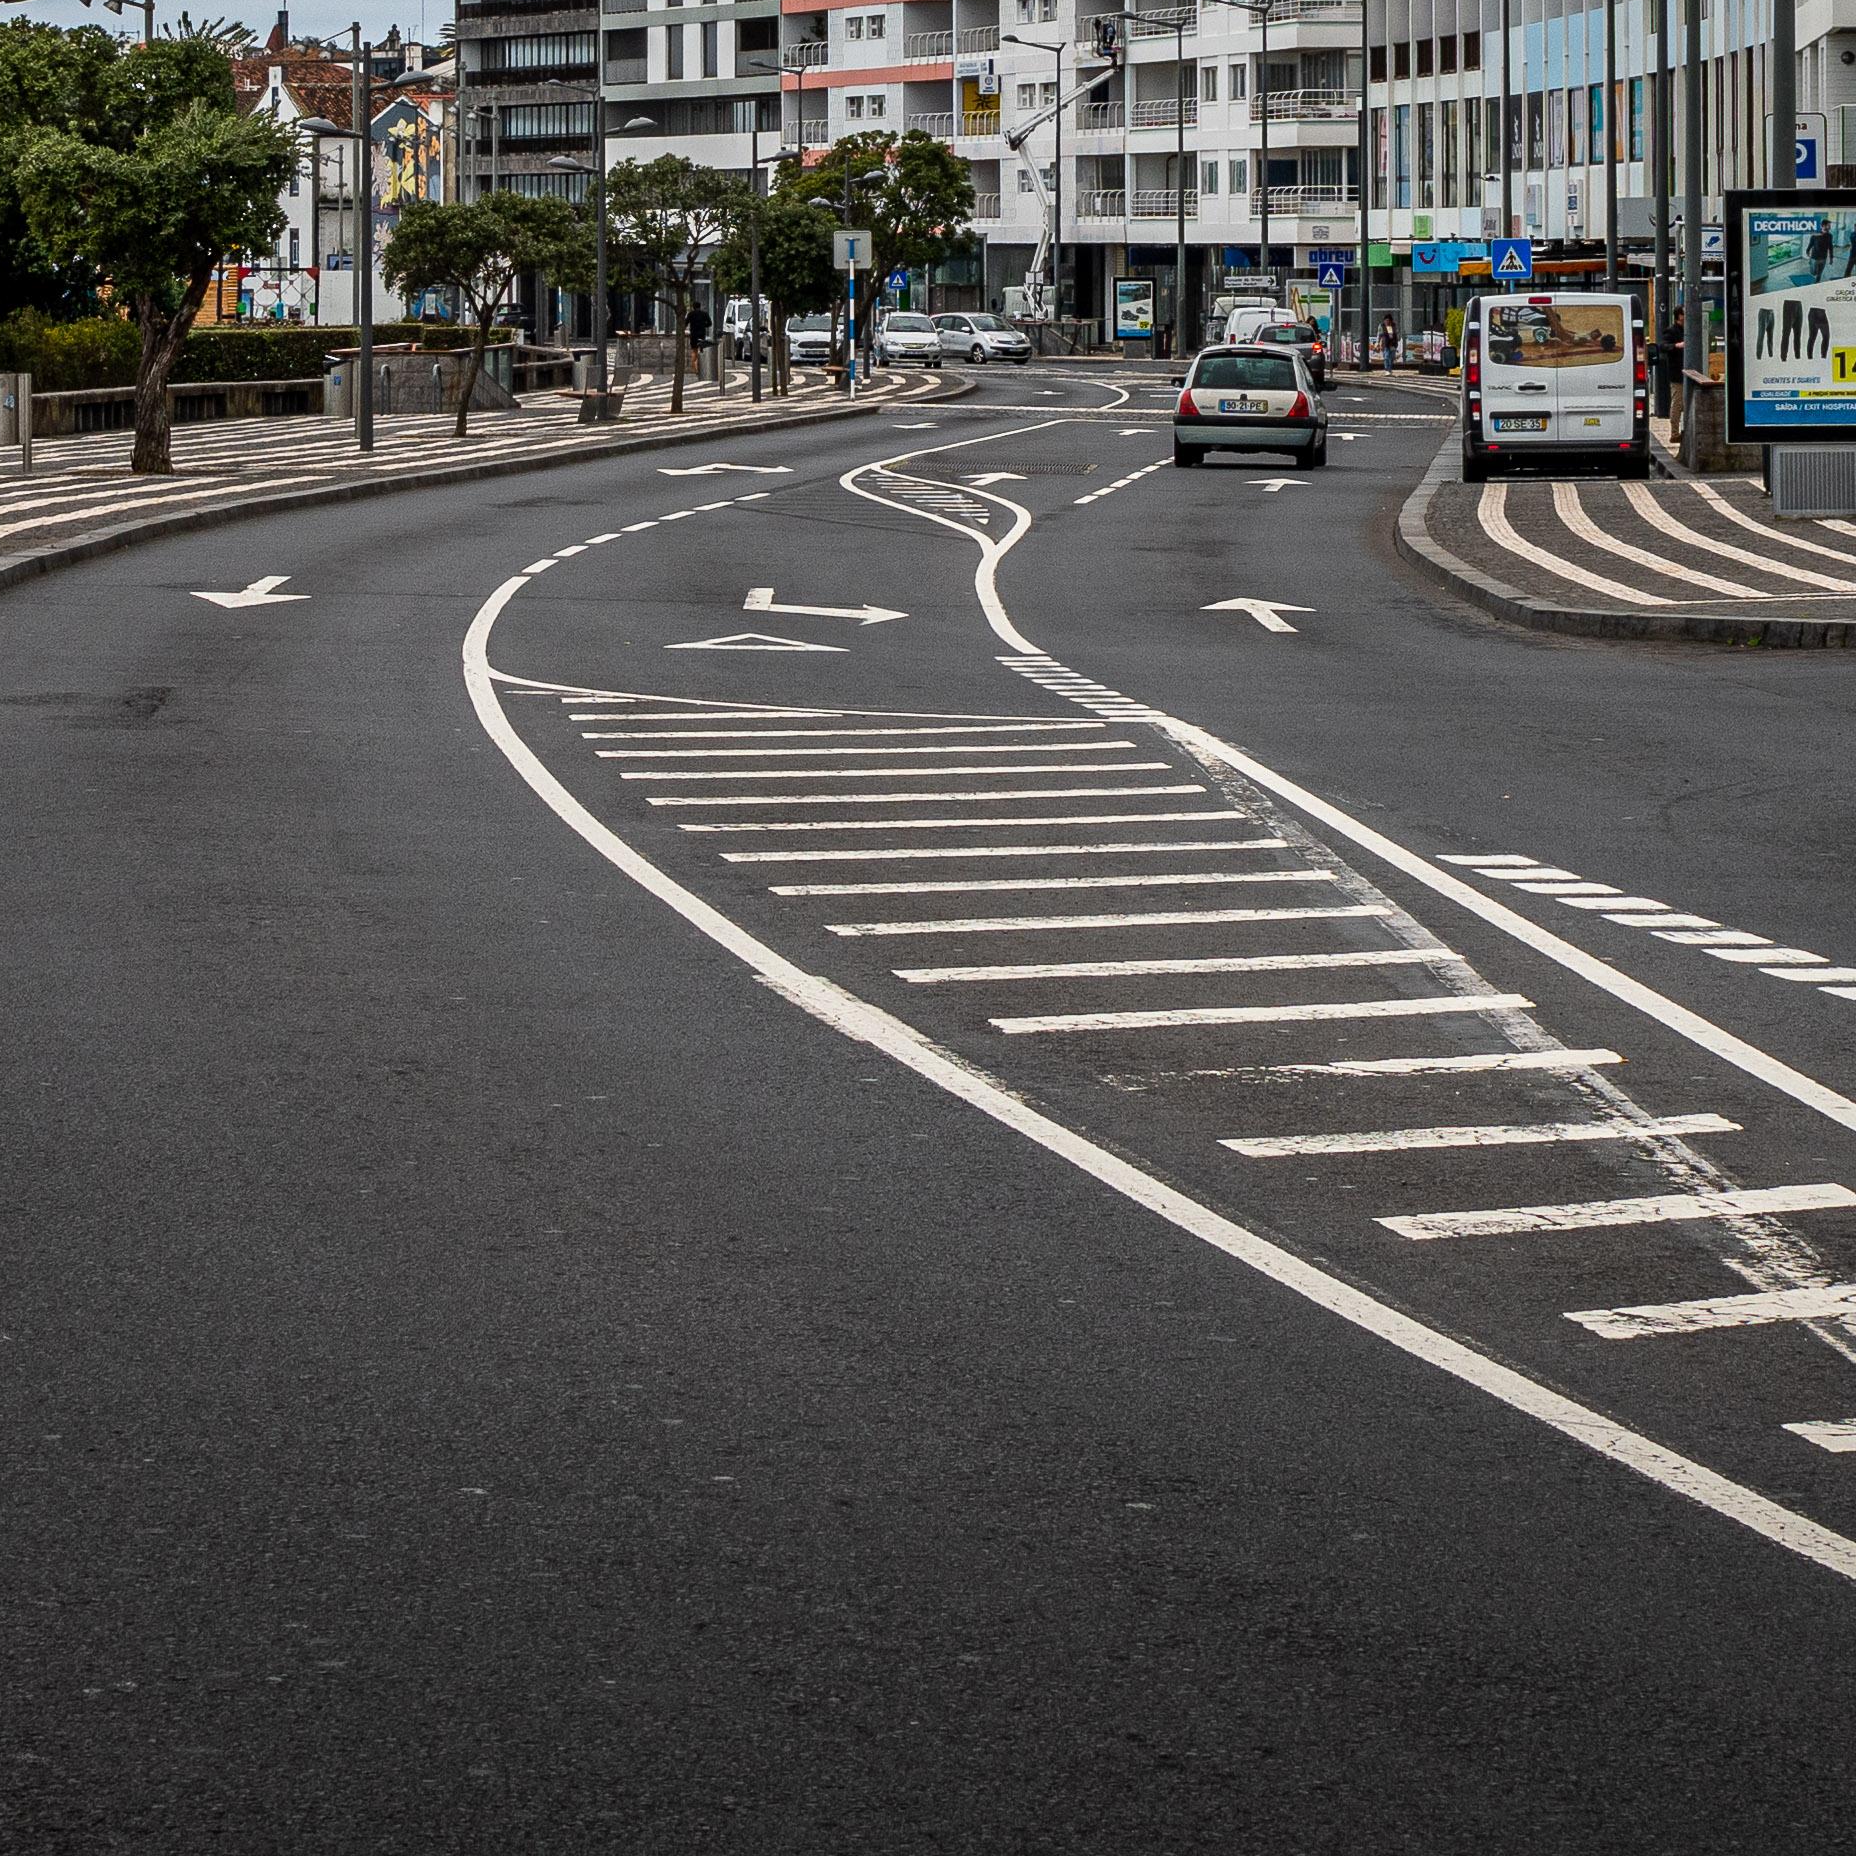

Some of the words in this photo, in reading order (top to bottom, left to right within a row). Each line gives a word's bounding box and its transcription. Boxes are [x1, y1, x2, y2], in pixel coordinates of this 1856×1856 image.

[1754, 220, 1818, 232] DECATHLON
[1308, 247, 1355, 262] abreu
[1775, 401, 1798, 411] SAÍDA
[1804, 402, 1820, 410] EXIT
